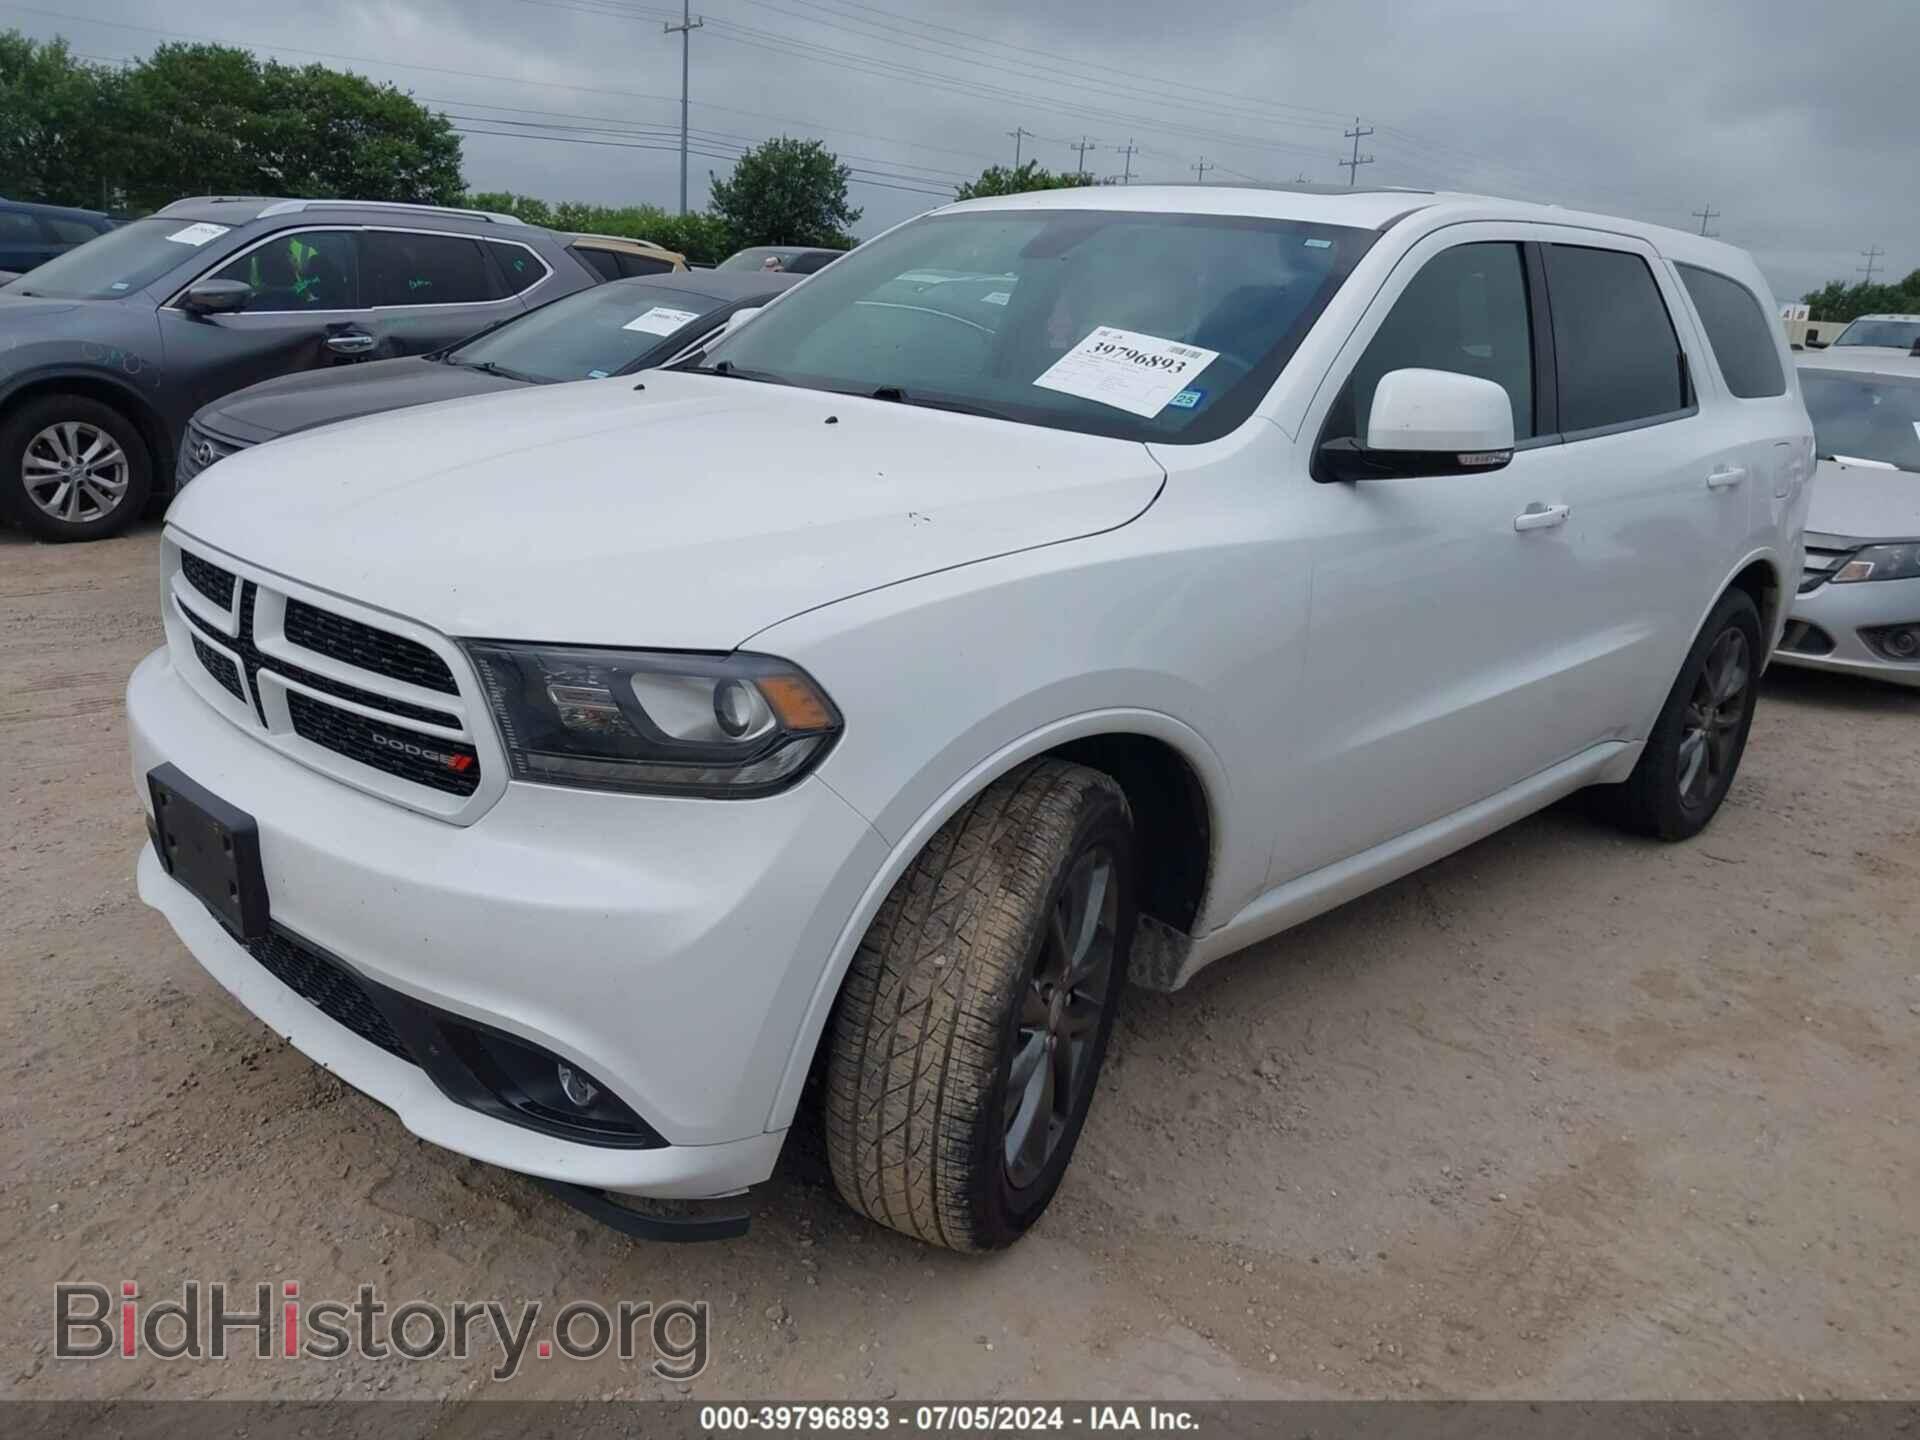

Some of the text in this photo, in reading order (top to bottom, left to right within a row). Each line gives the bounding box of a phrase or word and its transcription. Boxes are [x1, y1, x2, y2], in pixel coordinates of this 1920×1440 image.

[1086, 342, 1187, 374] 39796893
[1176, 393, 1196, 404] 25
[372, 734, 457, 766] DODGE
